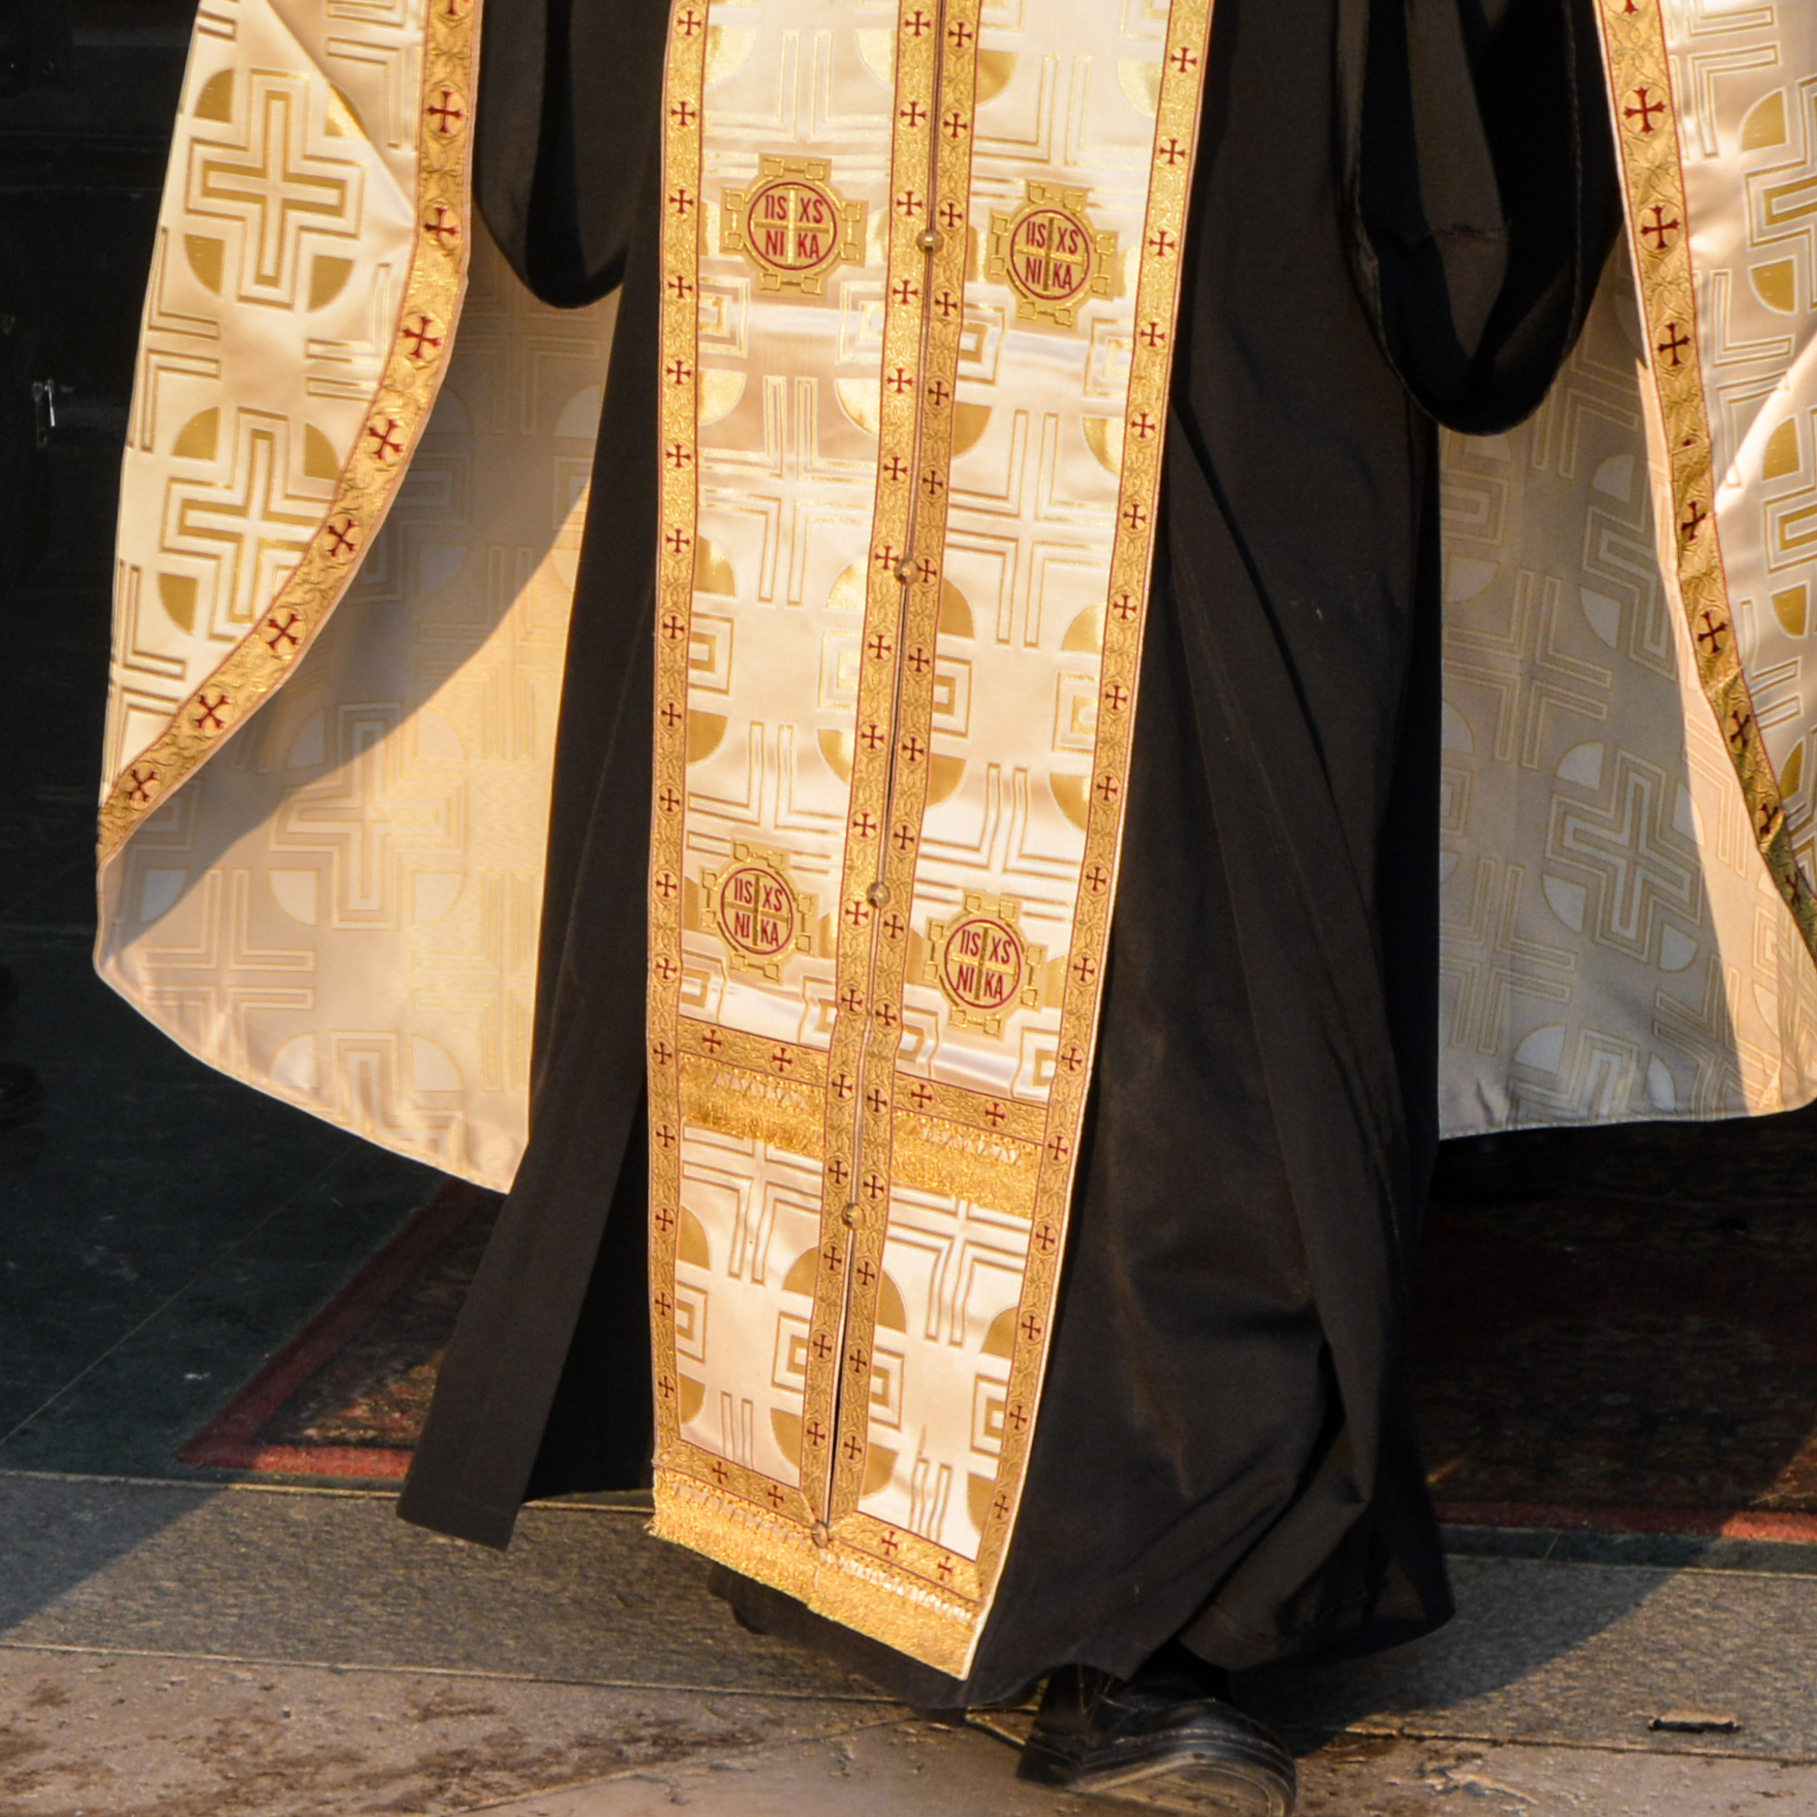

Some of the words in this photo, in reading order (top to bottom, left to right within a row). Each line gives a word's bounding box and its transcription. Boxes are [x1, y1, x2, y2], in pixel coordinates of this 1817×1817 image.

[799, 197, 824, 224] XS
[766, 229, 785, 257] NI
[797, 232, 820, 261] KA
[1056, 226, 1080, 255] XS
[1025, 256, 1043, 285] NI
[1052, 262, 1073, 291] KA
[763, 884, 783, 913] XS
[734, 911, 751, 939] NI
[760, 918, 780, 948] KA
[989, 936, 1012, 965] XS
[956, 963, 975, 993] NI
[984, 971, 1003, 1002] KA
